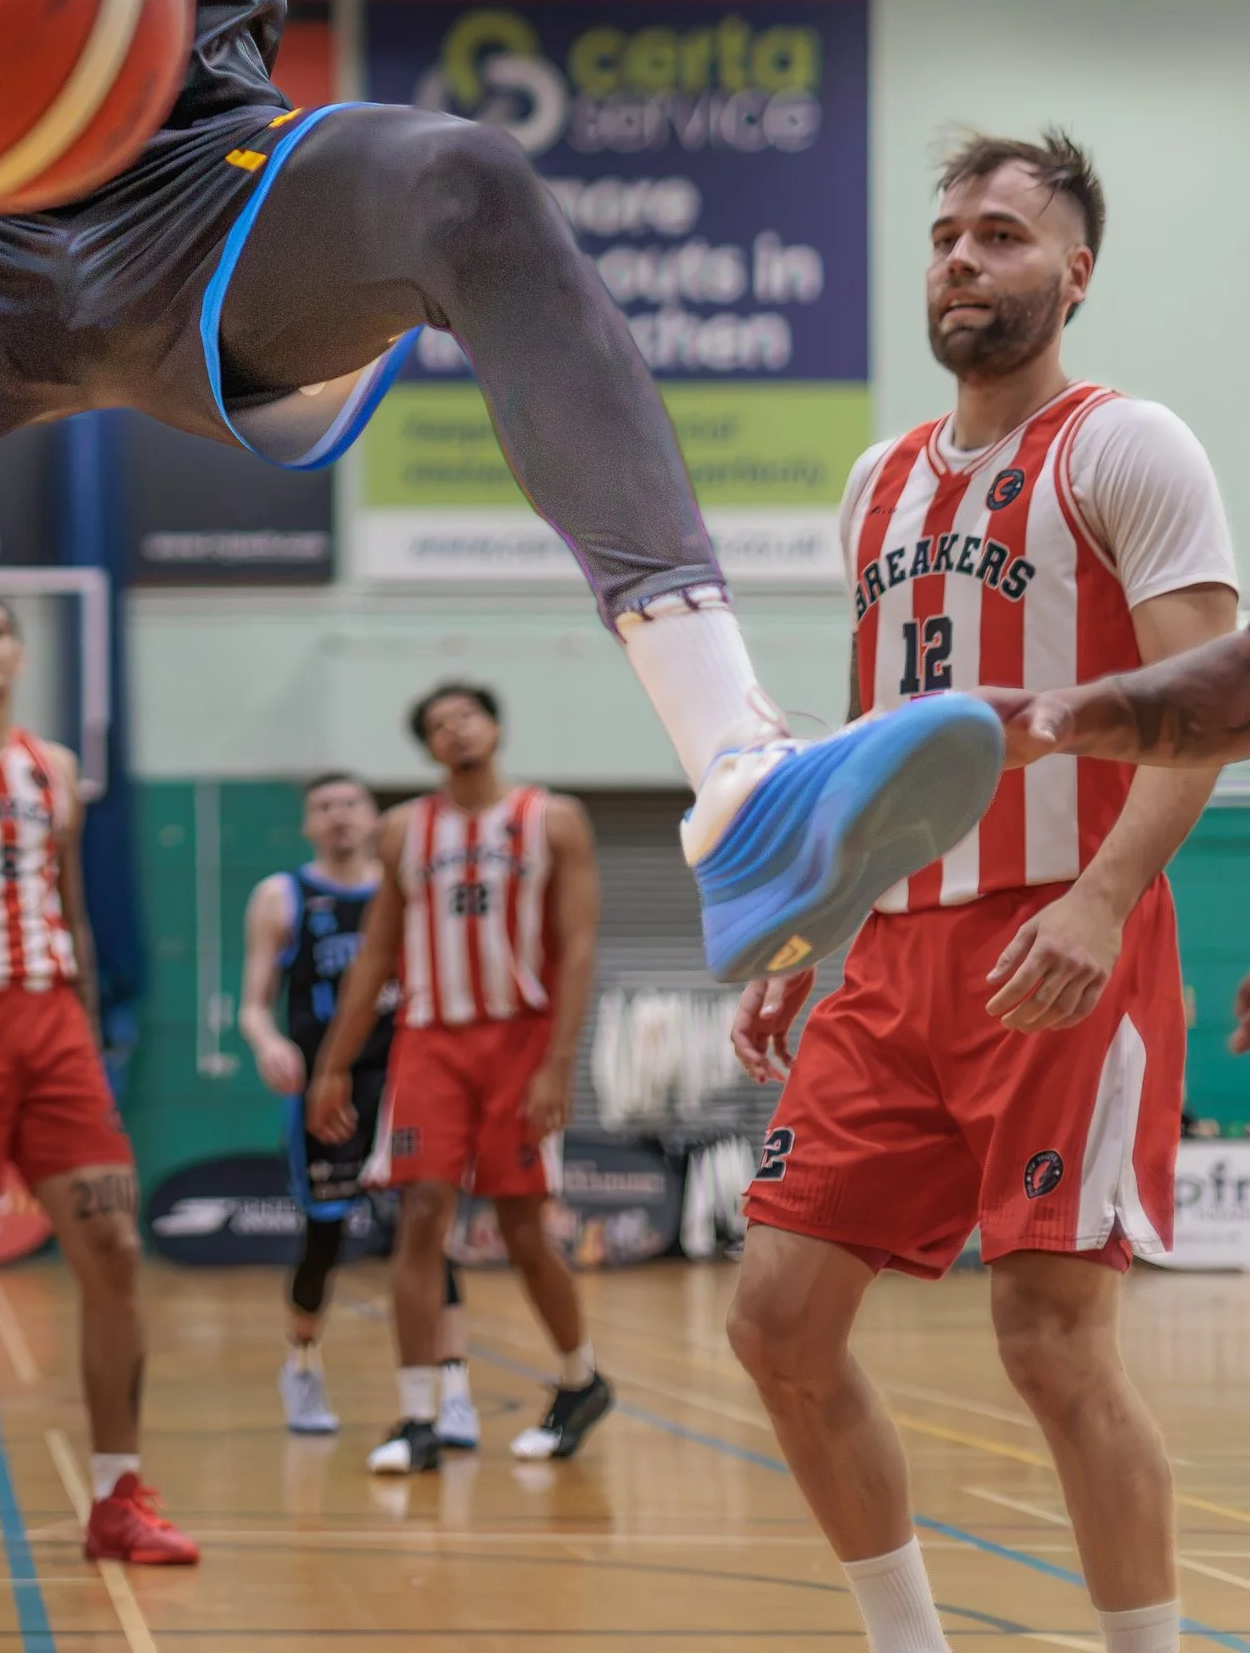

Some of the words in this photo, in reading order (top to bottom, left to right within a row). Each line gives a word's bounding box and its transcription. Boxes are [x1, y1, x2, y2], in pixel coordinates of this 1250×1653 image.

[568, 16, 820, 96] certa
[598, 237, 746, 304] outs
[752, 230, 825, 304] in
[628, 307, 792, 371] chen
[899, 615, 953, 696] 12
[754, 1126, 796, 1182] 2
